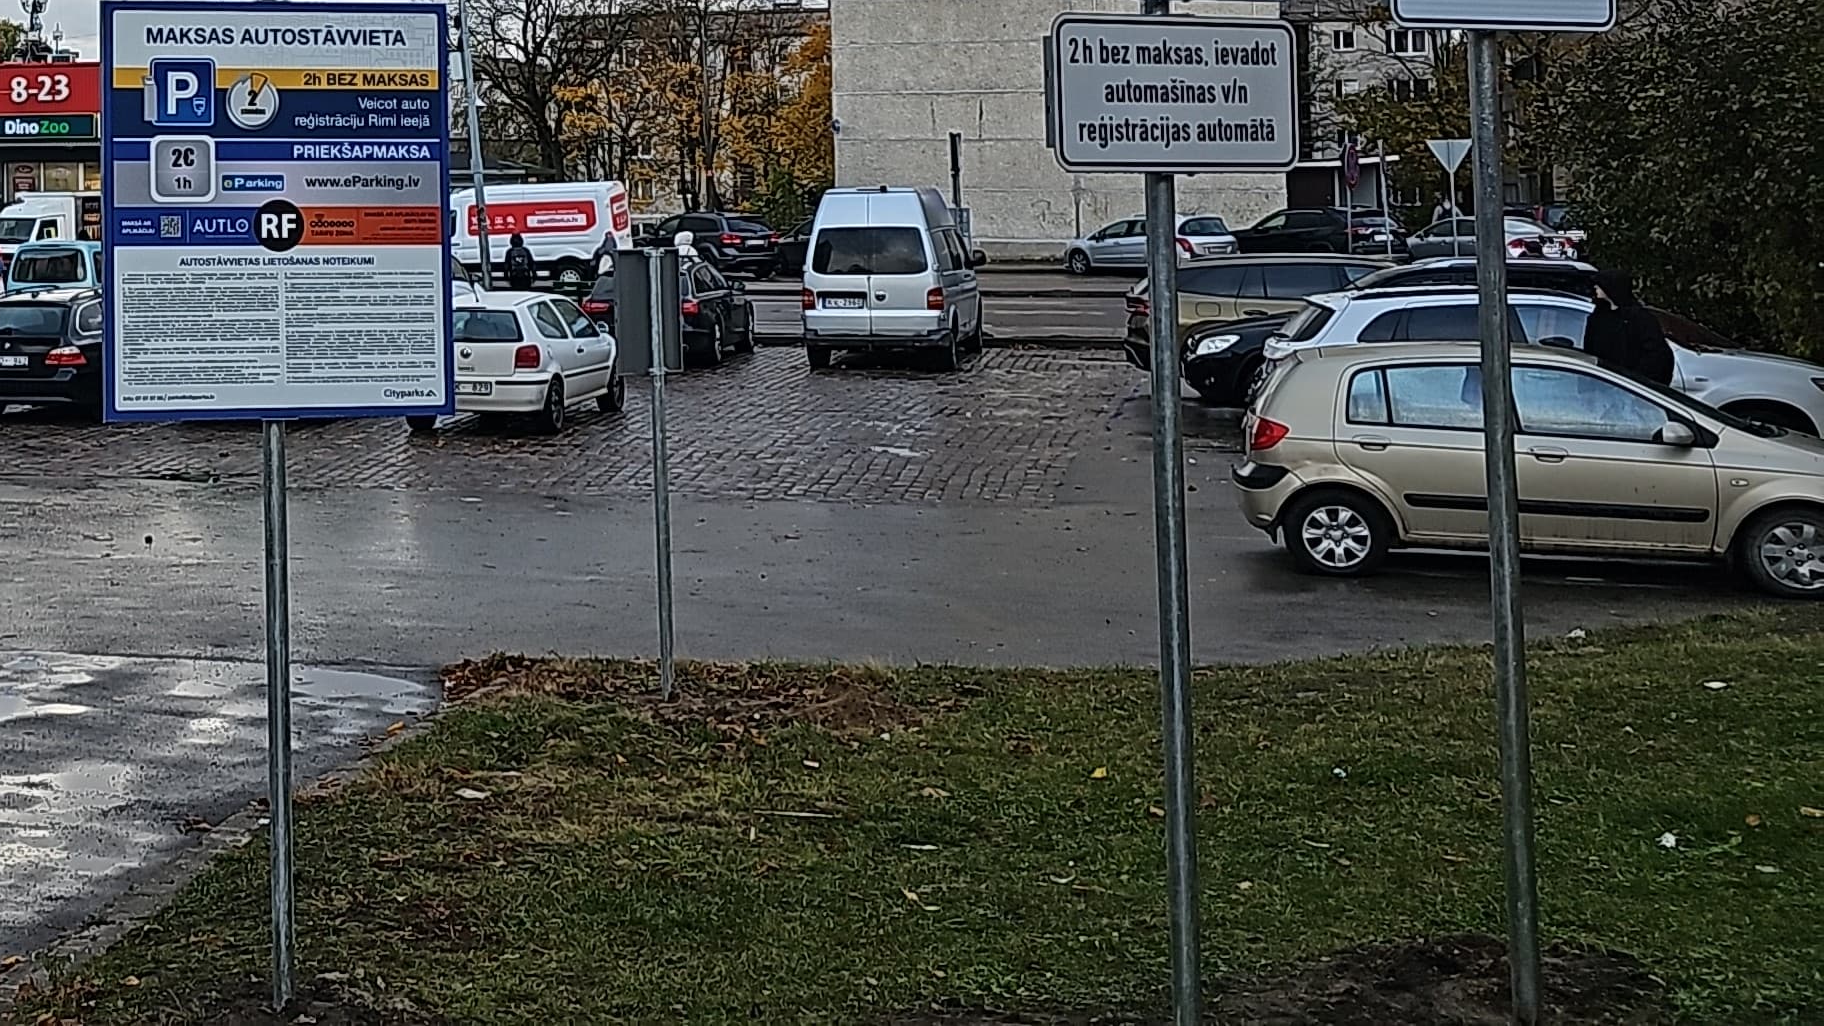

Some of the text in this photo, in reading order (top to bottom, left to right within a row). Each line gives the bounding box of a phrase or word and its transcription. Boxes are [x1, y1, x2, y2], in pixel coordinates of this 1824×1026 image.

[145, 24, 407, 46] MAKSAS AUTOSTĀVVIETA
[1099, 37, 1130, 64] bez
[1135, 39, 1209, 67] maksas,
[1214, 40, 1277, 66] ievadot
[303, 72, 430, 87] 2h BEZ MAKSAS
[9, 74, 70, 103] 8-23
[1104, 77, 1249, 104] automašīnas v/n
[357, 96, 430, 110] Veicot auto
[4, 118, 70, 135] DinoZoo
[294, 113, 365, 130] reģistrāciju
[368, 113, 397, 127] Rimi
[1078, 116, 1276, 149] reģistrācijas automātā
[293, 142, 431, 159] PRIEKŠAPMAKSA
[174, 176, 192, 189] 1h
[304, 174, 421, 191] www.eParking.lv
[260, 213, 297, 239] RF
[179, 254, 375, 267] AUTOSTĀVVIETAS LIETOŠANAS NOTEIKUMI
